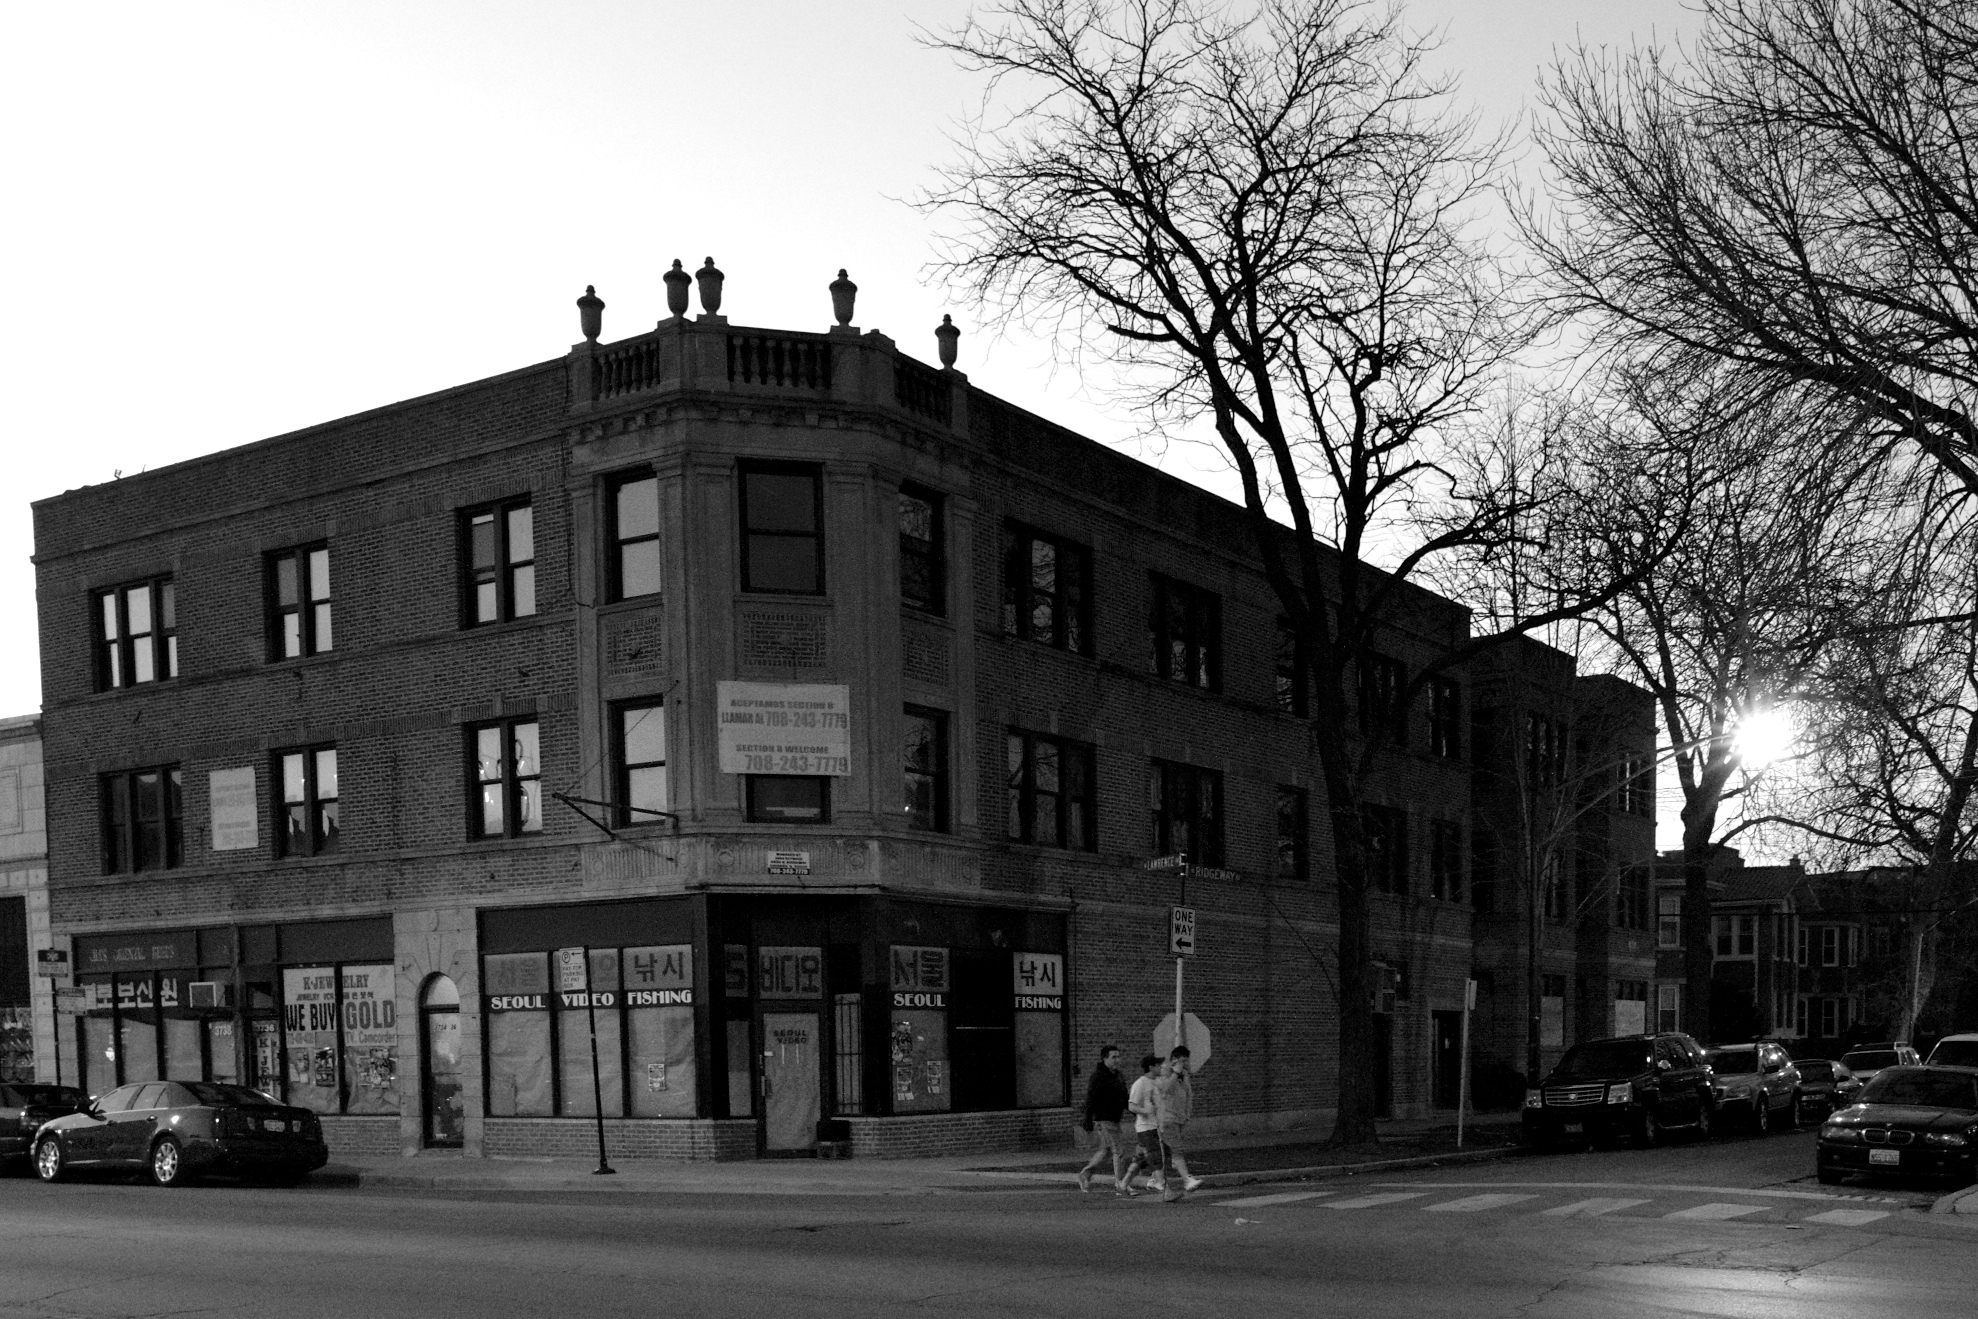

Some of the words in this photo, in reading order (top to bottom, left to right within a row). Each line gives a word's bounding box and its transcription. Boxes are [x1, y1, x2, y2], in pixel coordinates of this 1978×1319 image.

[730, 700, 785, 709] ACEPTAMOS
[787, 701, 825, 709] SECTION
[721, 712, 754, 723] LLAMAR
[765, 711, 848, 729] 708-243-7779
[736, 744, 775, 752] SECTION
[785, 745, 829, 754] WELCOME
[744, 754, 849, 773] 708-243-7779
[1147, 856, 1175, 870] LAWRENCE
[1195, 866, 1235, 881] RIDGEWAY
[1175, 910, 1193, 923] ONE
[1174, 924, 1193, 936] WAY
[635, 951, 684, 982] 낚시
[761, 955, 820, 993] 비디오
[893, 949, 944, 988] 서울
[1019, 960, 1056, 987] 낚시
[491, 994, 546, 1009] SEOUL
[561, 992, 615, 1007] VIDEO
[627, 989, 693, 1005] FISHING
[893, 993, 946, 1007] SEOUL
[1014, 996, 1062, 1009] FISHING
[285, 1004, 306, 1032] WE
[310, 1003, 337, 1031] BUY
[345, 1000, 396, 1030] GOLD
[773, 1029, 807, 1037] SEOUL
